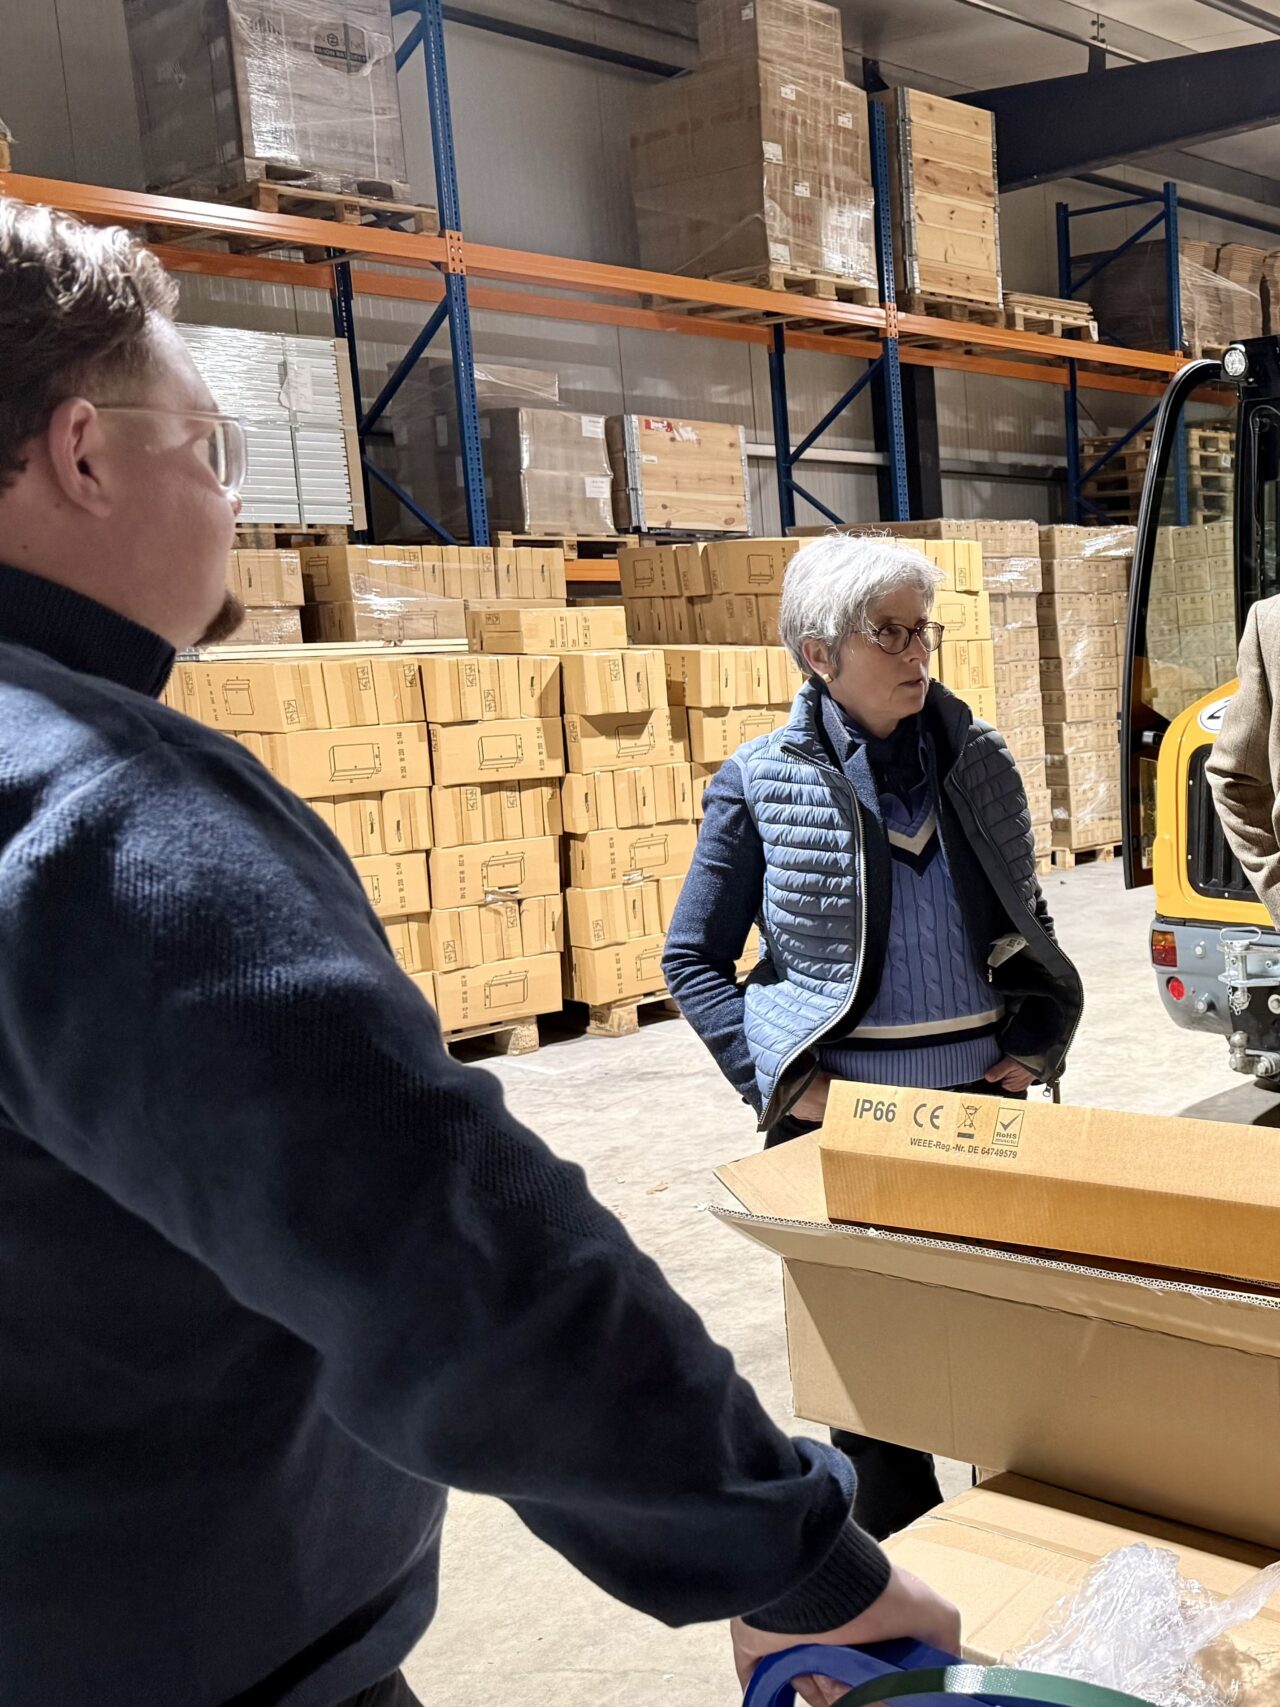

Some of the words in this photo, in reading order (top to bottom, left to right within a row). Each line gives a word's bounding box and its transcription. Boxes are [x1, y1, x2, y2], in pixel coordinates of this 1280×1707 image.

[853, 1098, 898, 1122] IP66
[913, 1103, 944, 1130] CE
[996, 1131, 1017, 1140] RoHS
[910, 1137, 966, 1153] WEEE-Reg.-Nr.
[967, 1145, 980, 1154] DE
[980, 1146, 1018, 1159] 64749579
